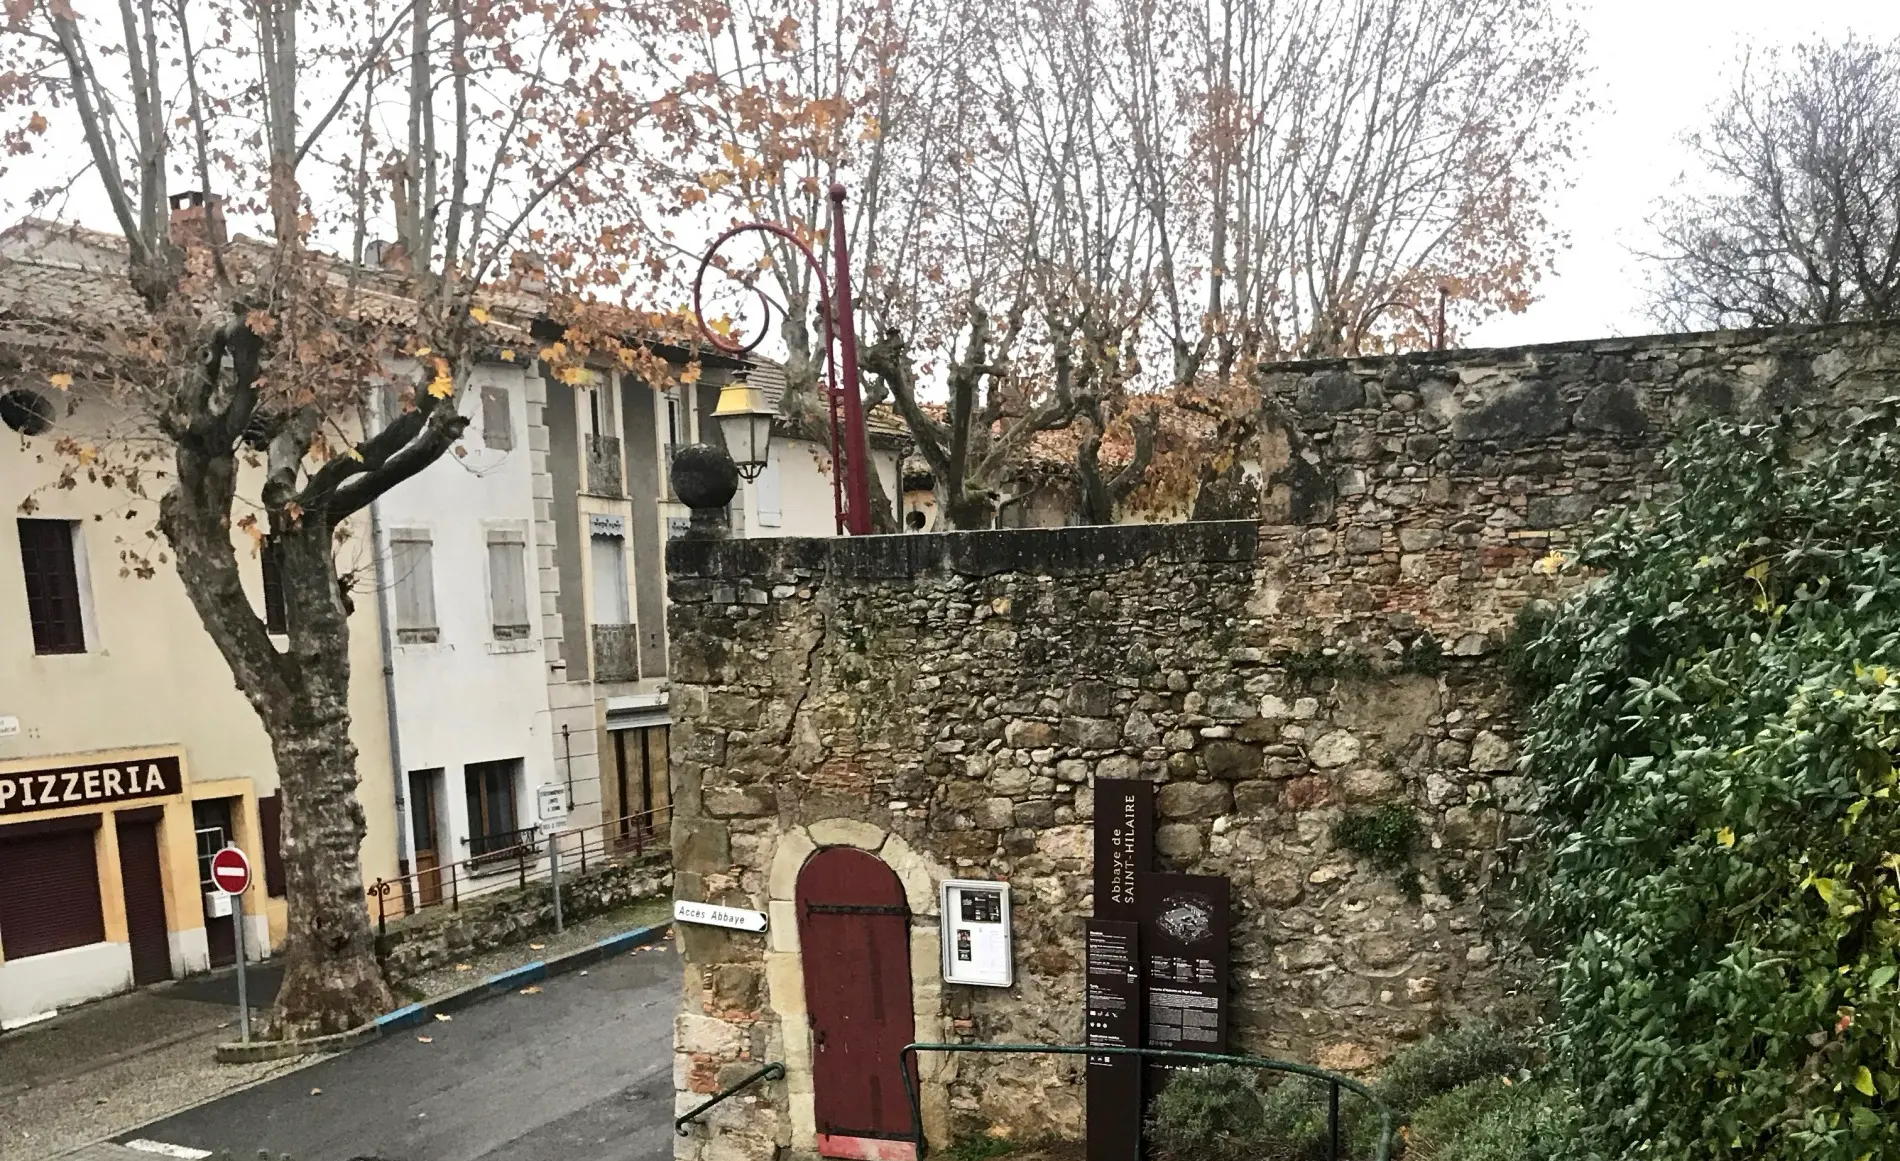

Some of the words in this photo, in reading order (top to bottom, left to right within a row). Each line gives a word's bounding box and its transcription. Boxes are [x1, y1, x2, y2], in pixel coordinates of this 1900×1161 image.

[0, 764, 166, 809] PIZZERIA
[1111, 828, 1121, 846] de
[1124, 795, 1135, 904] SAINT-HILAIRE
[1111, 851, 1123, 903] Abbaye
[678, 906, 706, 919] Accès
[710, 911, 746, 926] Abbaye
